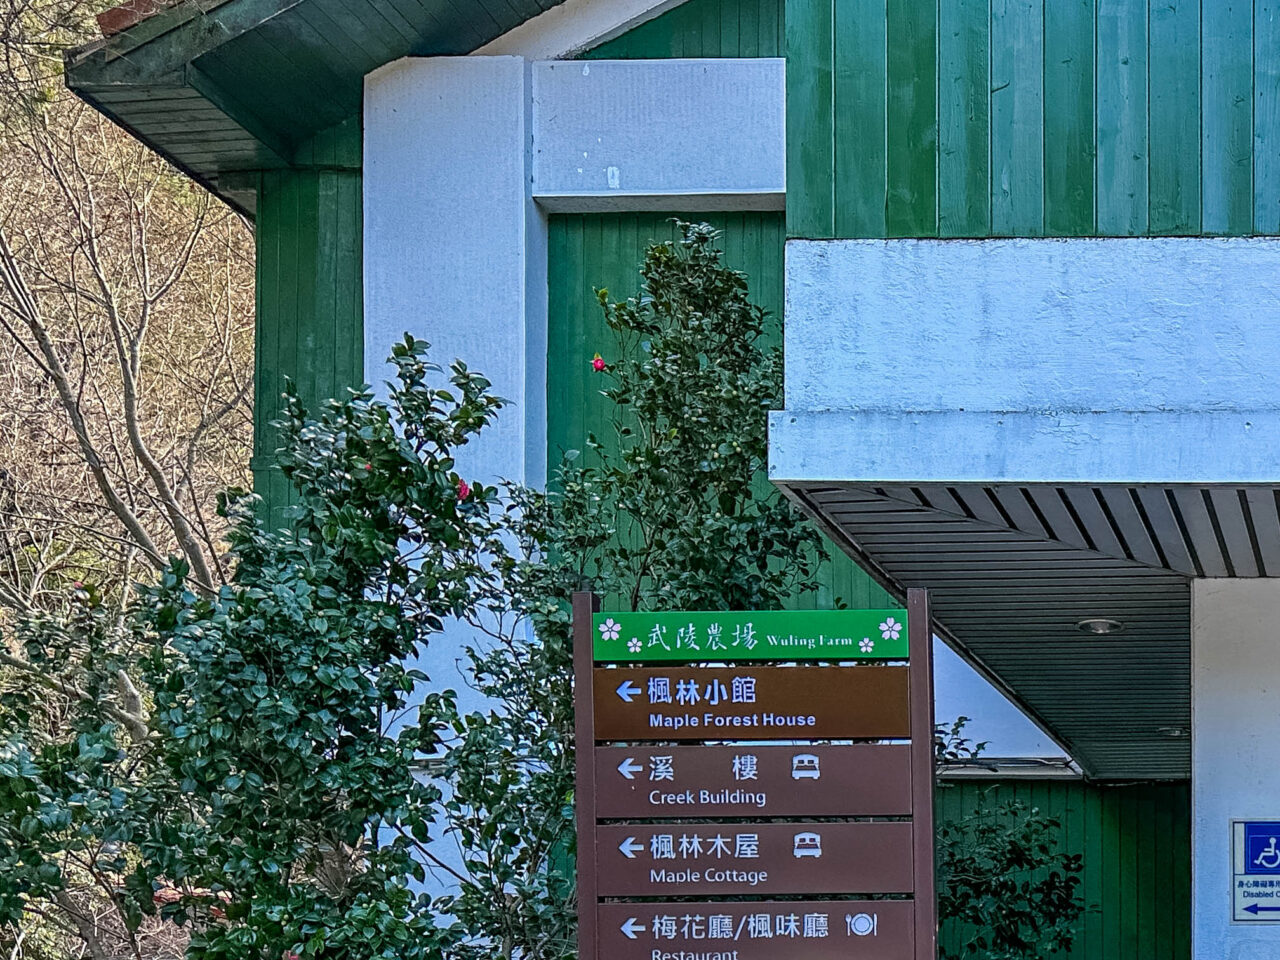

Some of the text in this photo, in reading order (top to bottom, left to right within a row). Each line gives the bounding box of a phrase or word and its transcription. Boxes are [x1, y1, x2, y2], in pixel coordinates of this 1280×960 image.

[647, 623, 853, 651] 武陵農場 Wuling Farm
[647, 677, 757, 705] 楓林小館
[649, 713, 816, 729] Maple Forest House
[649, 790, 767, 808] Creek Building
[650, 834, 760, 859] 楓林木屋
[650, 868, 768, 886] Maple Cottage
[1243, 890, 1274, 898] Disabled
[651, 912, 829, 941] 梅花廳/楓味廳
